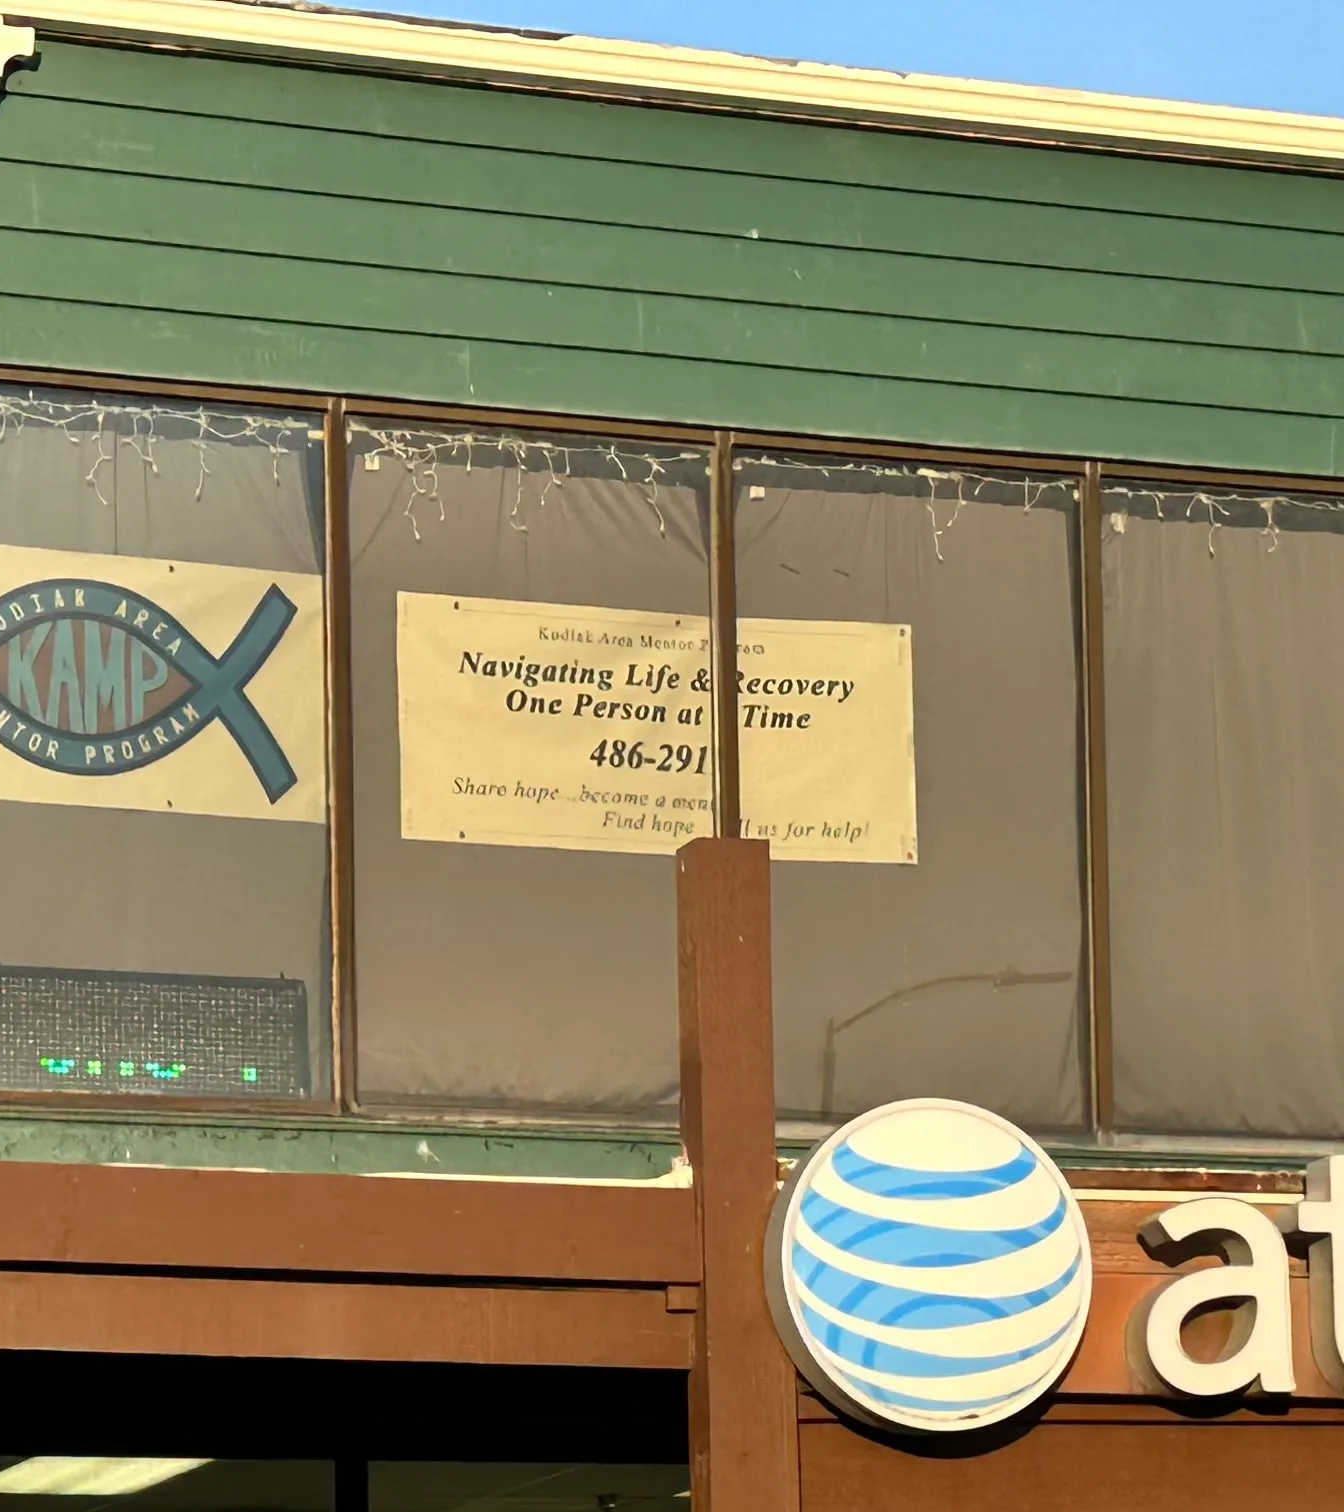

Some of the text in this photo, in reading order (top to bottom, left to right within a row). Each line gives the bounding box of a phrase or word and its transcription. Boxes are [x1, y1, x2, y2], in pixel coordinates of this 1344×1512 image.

[114, 599, 182, 657] AREA
[7, 617, 169, 736] KAMP
[458, 650, 614, 692] Navigating
[624, 663, 680, 694] Life
[690, 667, 712, 693] &
[505, 688, 812, 729] One Person at Time
[84, 702, 201, 765] PROGRAM
[589, 738, 709, 775] 486-291
[451, 776, 507, 797] Share
[601, 811, 646, 831] Find
[782, 820, 816, 841] for
